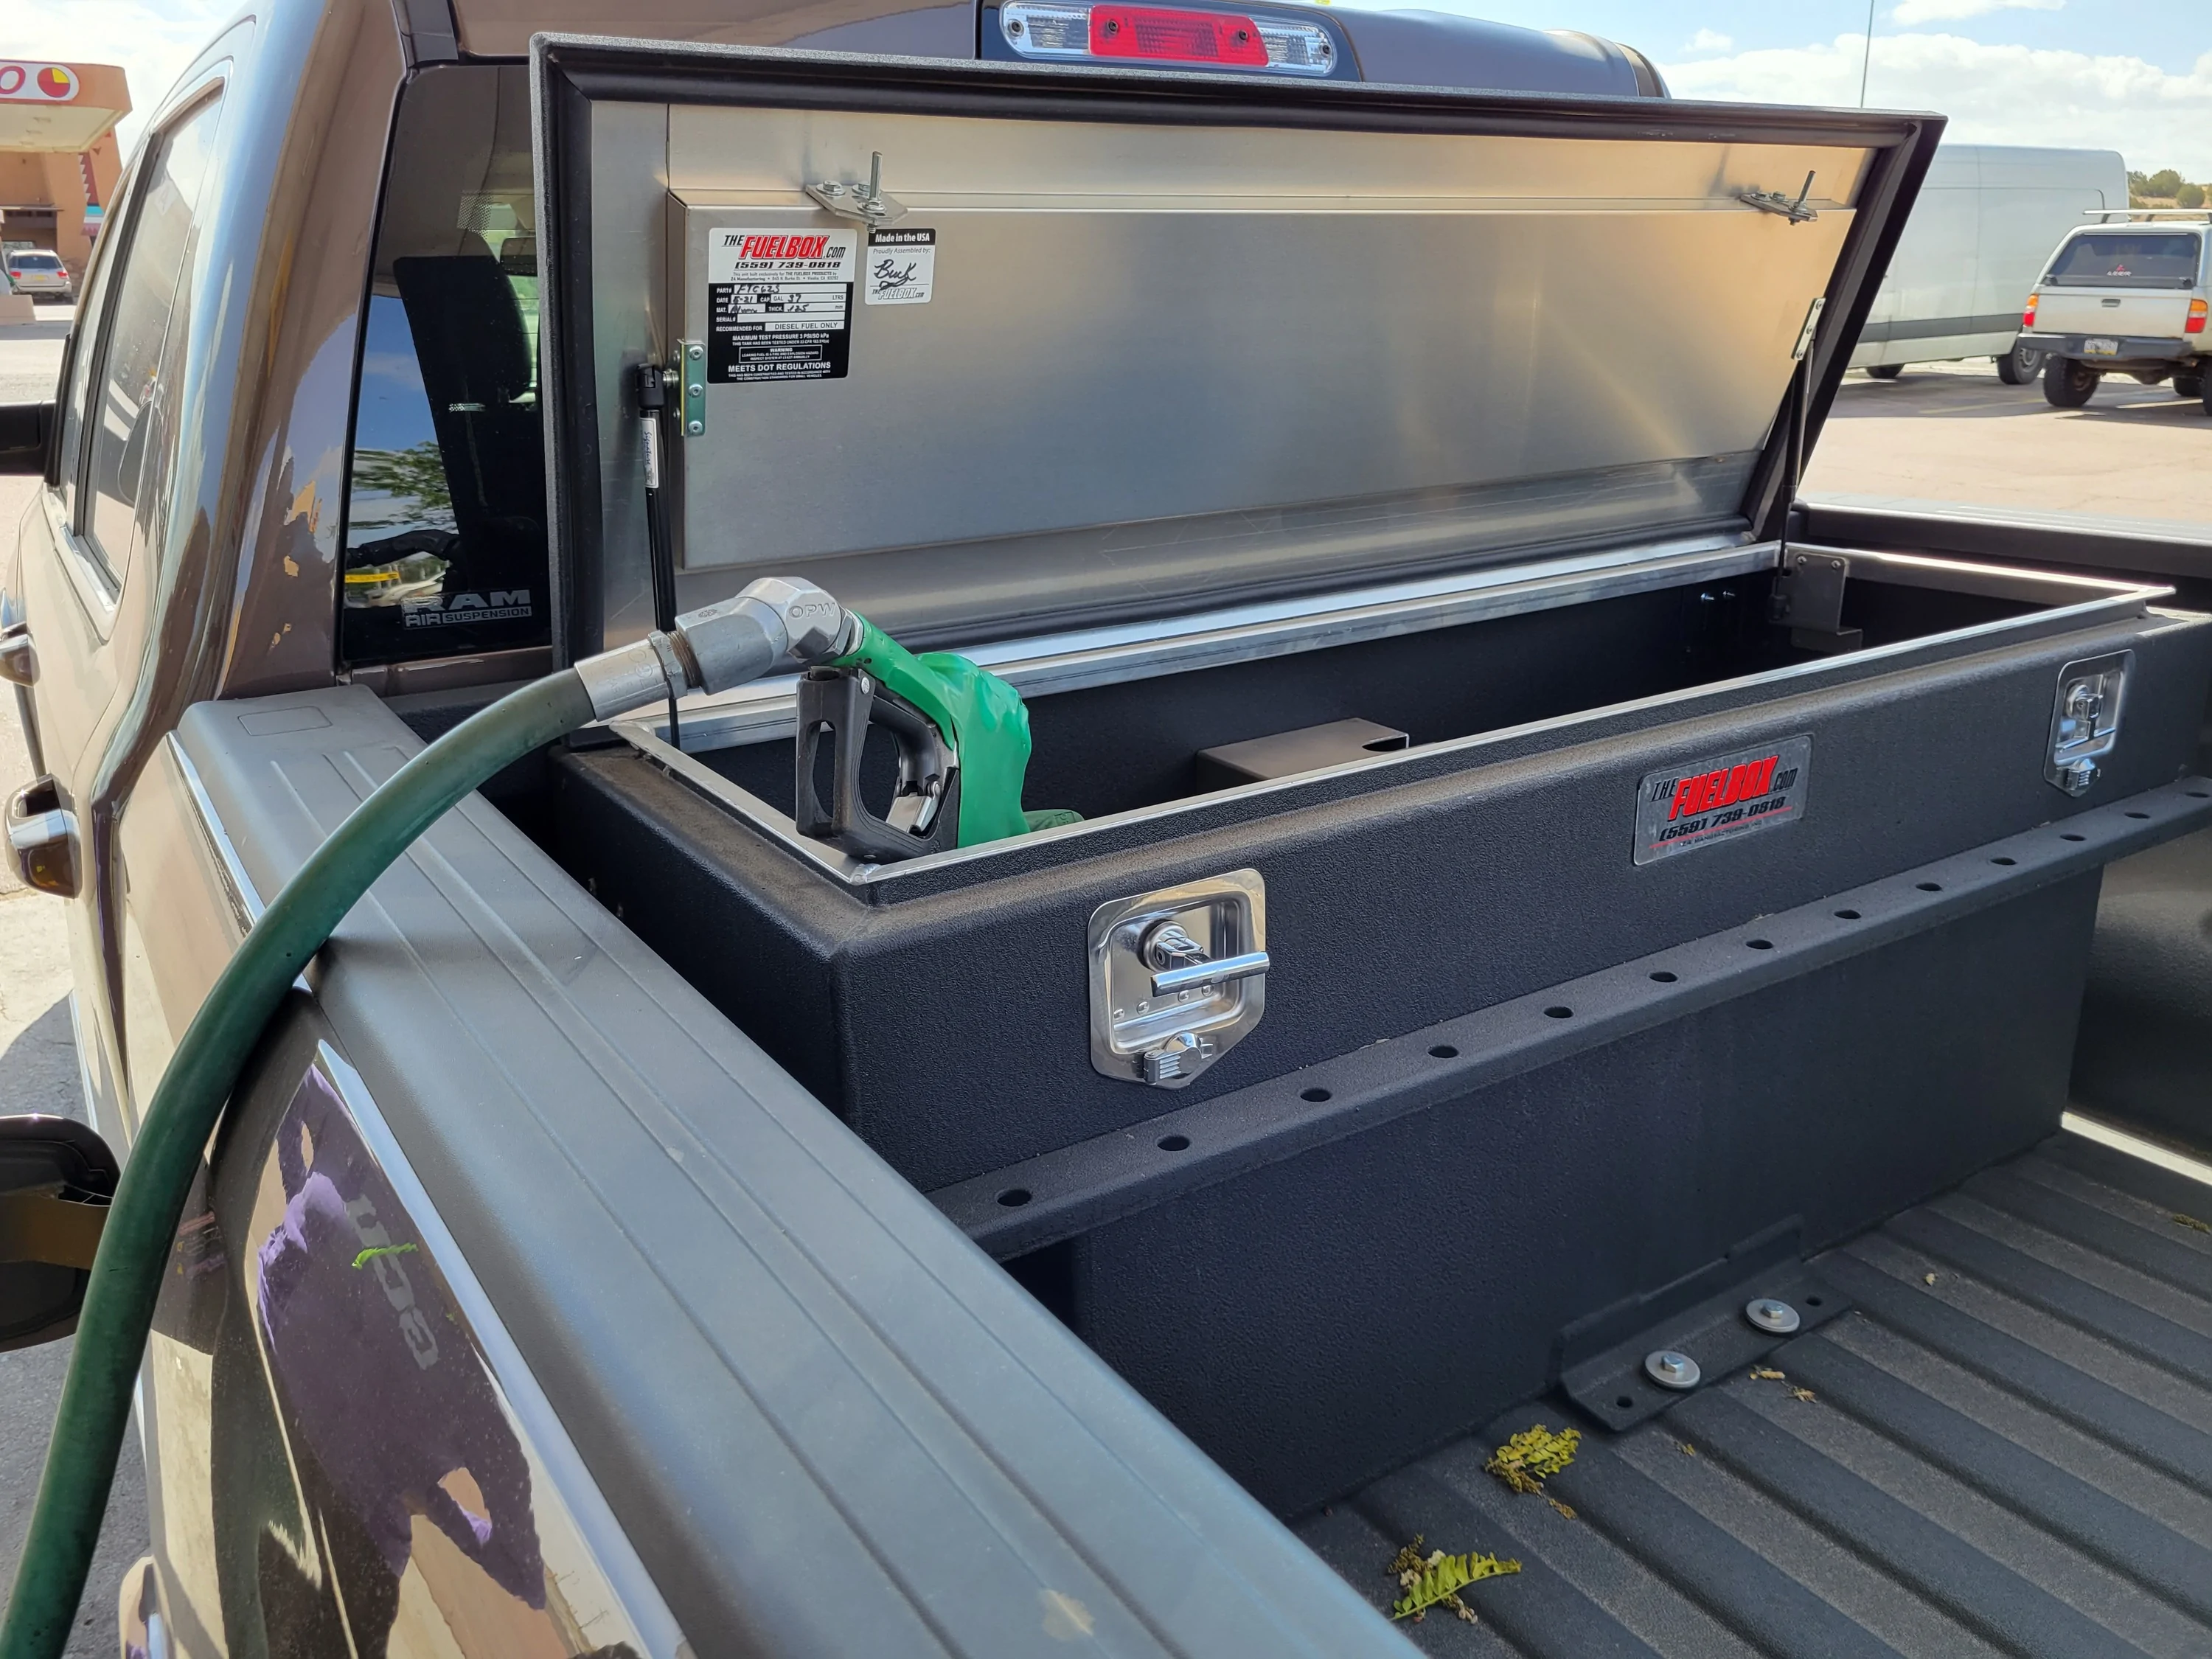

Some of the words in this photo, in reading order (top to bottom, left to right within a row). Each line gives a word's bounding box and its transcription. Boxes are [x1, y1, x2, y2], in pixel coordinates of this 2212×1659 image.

[723, 235, 745, 246] THE
[738, 235, 830, 260] FUELBOX
[875, 234, 895, 243] Made
[895, 233, 902, 242] in
[904, 233, 916, 242] the
[917, 233, 930, 242] USA
[878, 288, 917, 299] FUELBOX
[776, 362, 831, 370] REGULATIONS
[402, 589, 531, 613] RAM
[789, 602, 837, 619] OPW
[406, 613, 442, 627] AIR
[445, 608, 530, 622] SUSPENSION
[1651, 776, 1679, 802] THE
[1667, 755, 1779, 822] FUELBOX
[1711, 796, 1787, 827] 739-0818
[1694, 824, 1750, 845] MANUFACTURING
